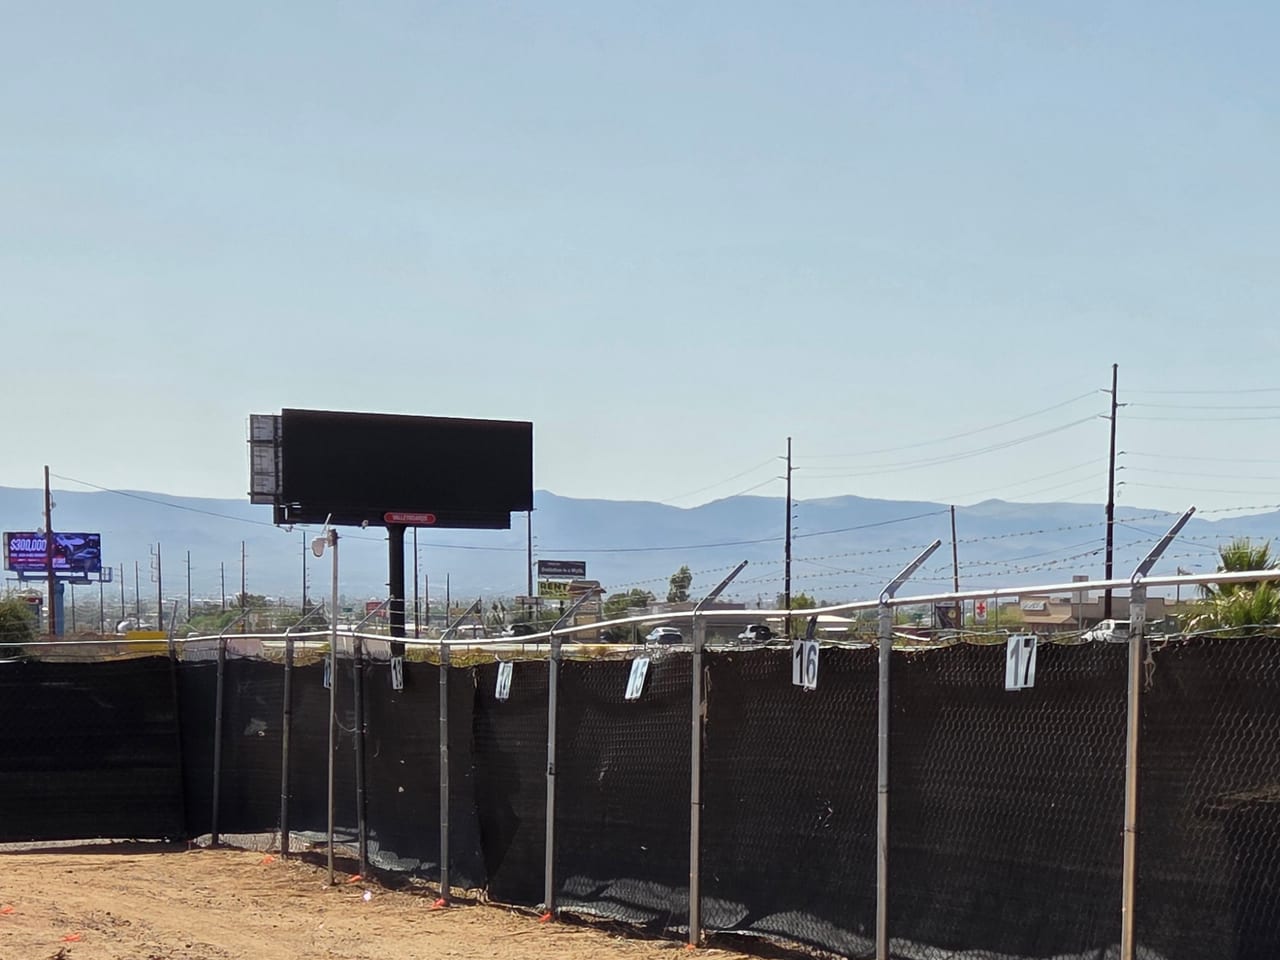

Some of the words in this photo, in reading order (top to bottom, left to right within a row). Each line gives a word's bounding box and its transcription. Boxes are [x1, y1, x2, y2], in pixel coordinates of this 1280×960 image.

[10, 538, 48, 552] $300,000
[795, 643, 817, 685] 16
[1010, 637, 1034, 686] 17
